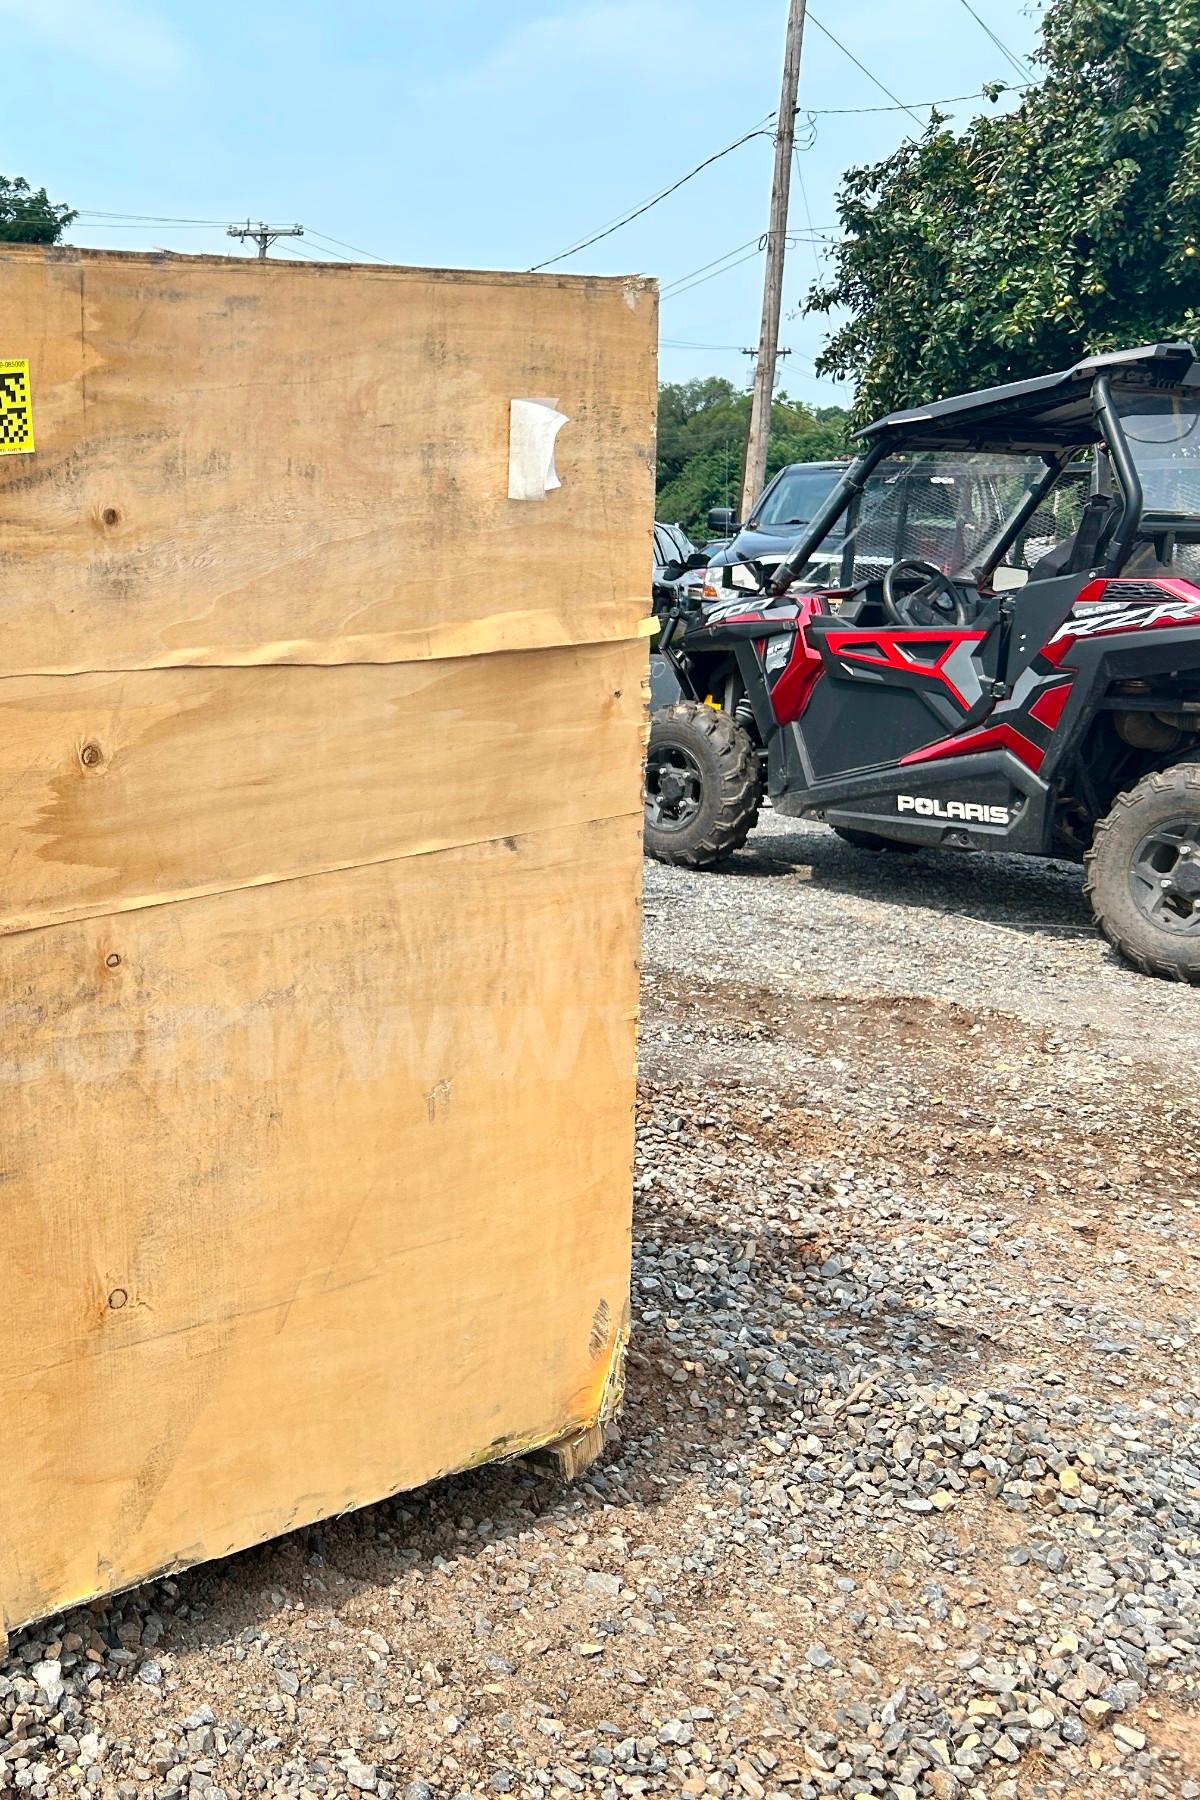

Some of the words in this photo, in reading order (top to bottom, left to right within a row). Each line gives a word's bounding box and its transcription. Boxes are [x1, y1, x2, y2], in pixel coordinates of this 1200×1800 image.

[1047, 602, 1199, 645] RZR
[1074, 602, 1122, 619] POLARIS
[896, 794, 1010, 825] POLARIS
